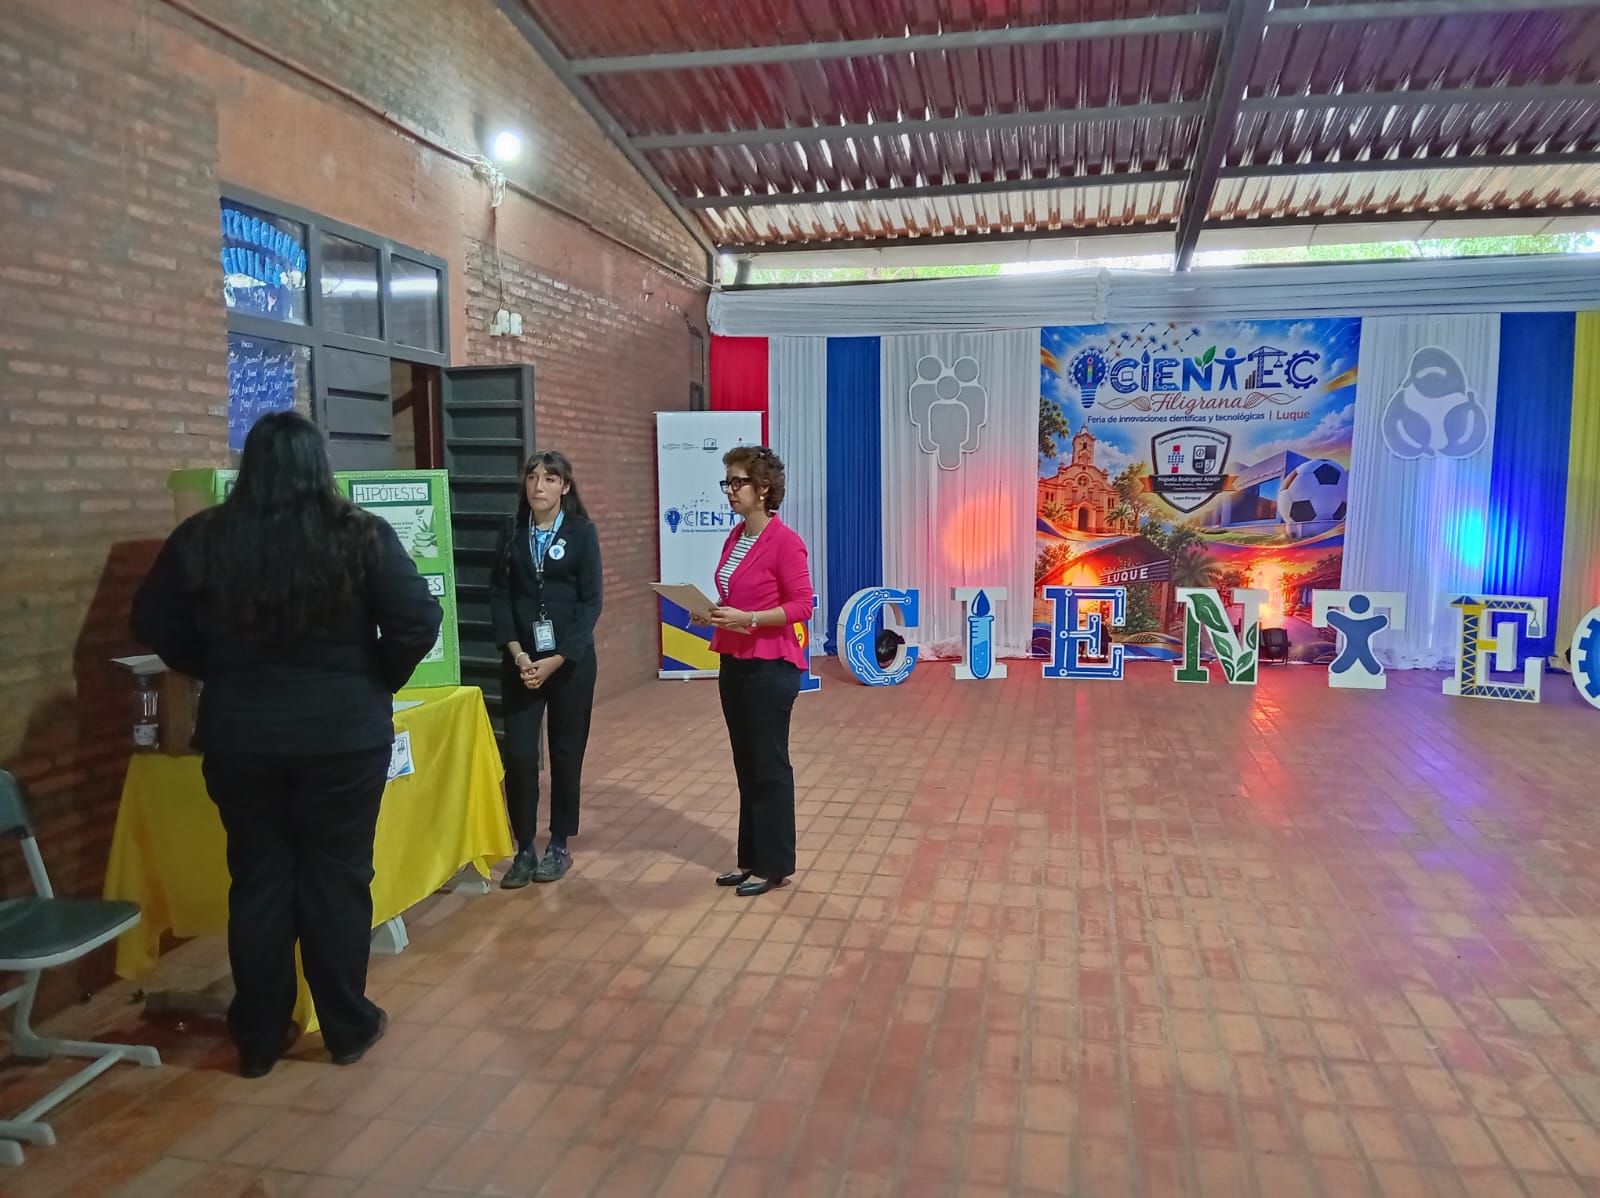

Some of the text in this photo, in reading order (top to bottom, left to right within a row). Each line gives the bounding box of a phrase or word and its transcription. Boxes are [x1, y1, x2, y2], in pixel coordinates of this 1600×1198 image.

[1150, 392, 1246, 414] Filigrana
[1088, 415, 1106, 424] Feria
[1107, 415, 1118, 423] de
[1119, 413, 1167, 423] innovaciones
[1276, 410, 1311, 421] Luque
[1107, 567, 1149, 584] LUQUE
